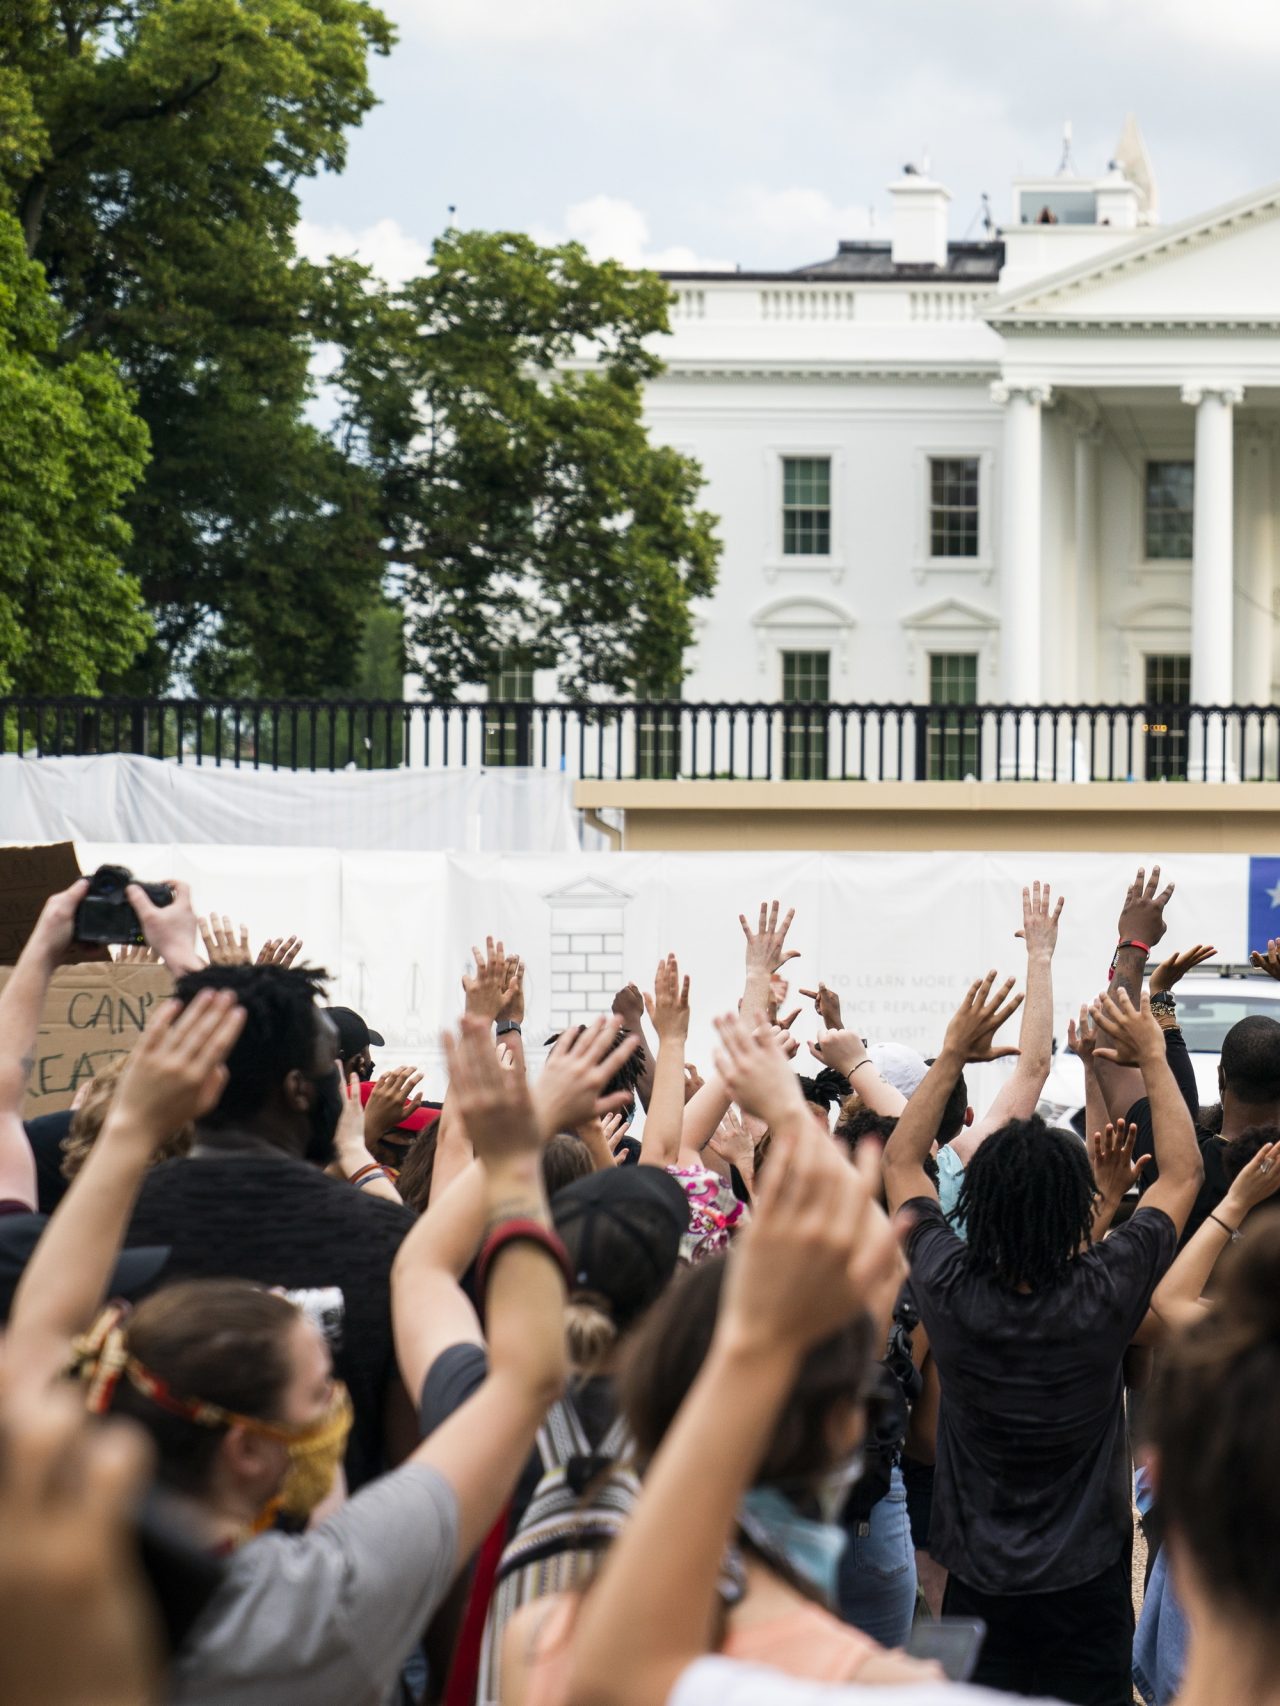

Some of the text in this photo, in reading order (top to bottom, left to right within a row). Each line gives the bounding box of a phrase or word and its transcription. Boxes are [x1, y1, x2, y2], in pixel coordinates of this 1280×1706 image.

[830, 974, 851, 988] TO
[856, 974, 905, 988] LEARN
[911, 974, 956, 988] MORE
[68, 992, 175, 1035] CAN'
[883, 1000, 961, 1014] REPLACEM
